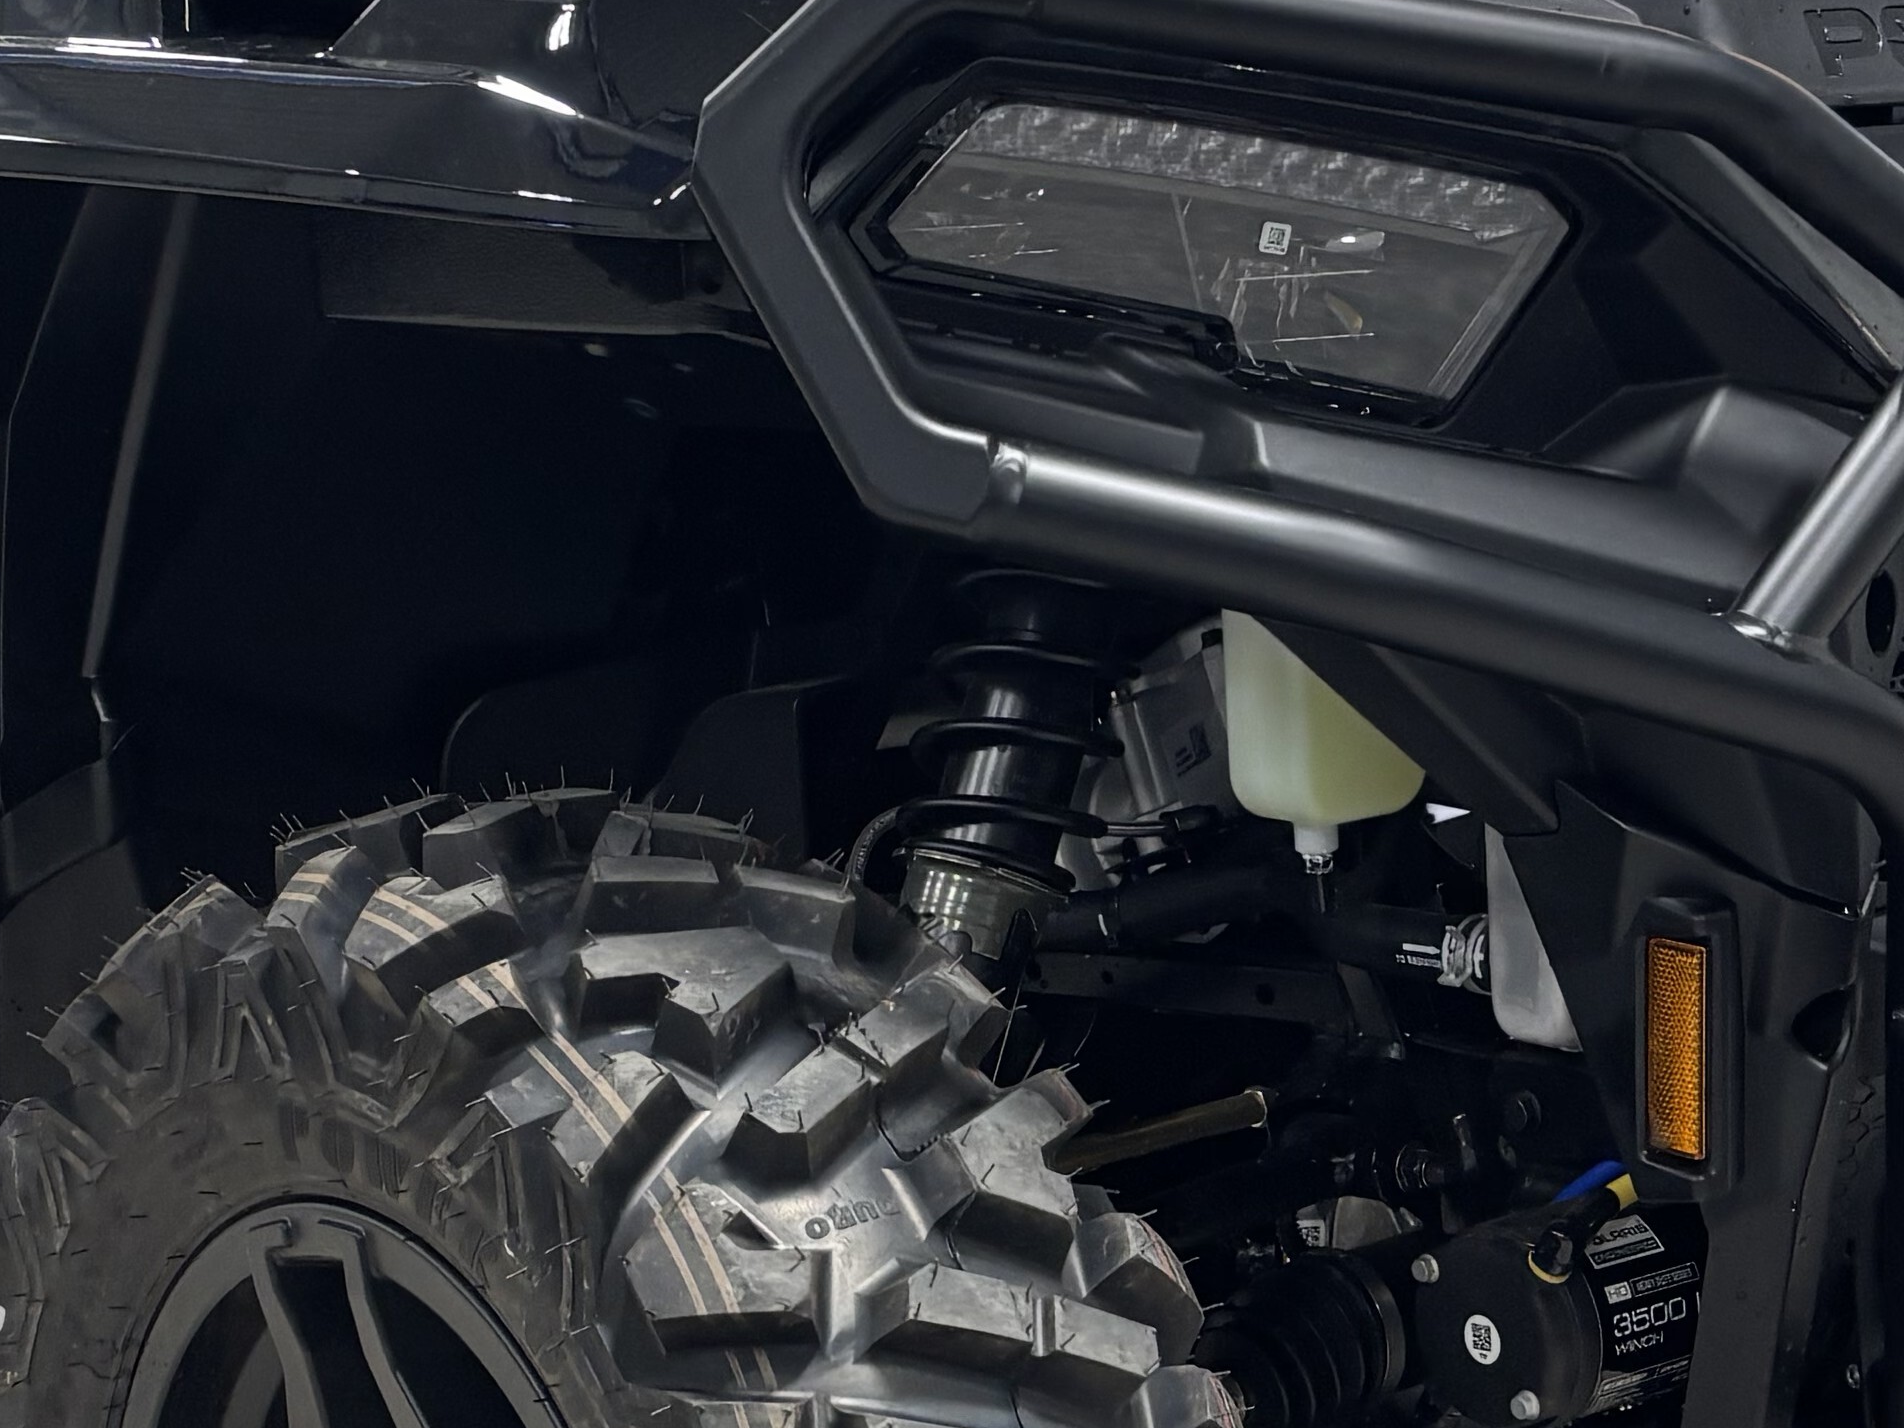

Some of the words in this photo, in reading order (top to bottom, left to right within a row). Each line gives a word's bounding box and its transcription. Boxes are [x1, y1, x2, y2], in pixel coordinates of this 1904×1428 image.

[1593, 1223, 1648, 1246] OLARIS
[1614, 1297, 1686, 1337] 3500
[1615, 1331, 1664, 1356] WINCH
